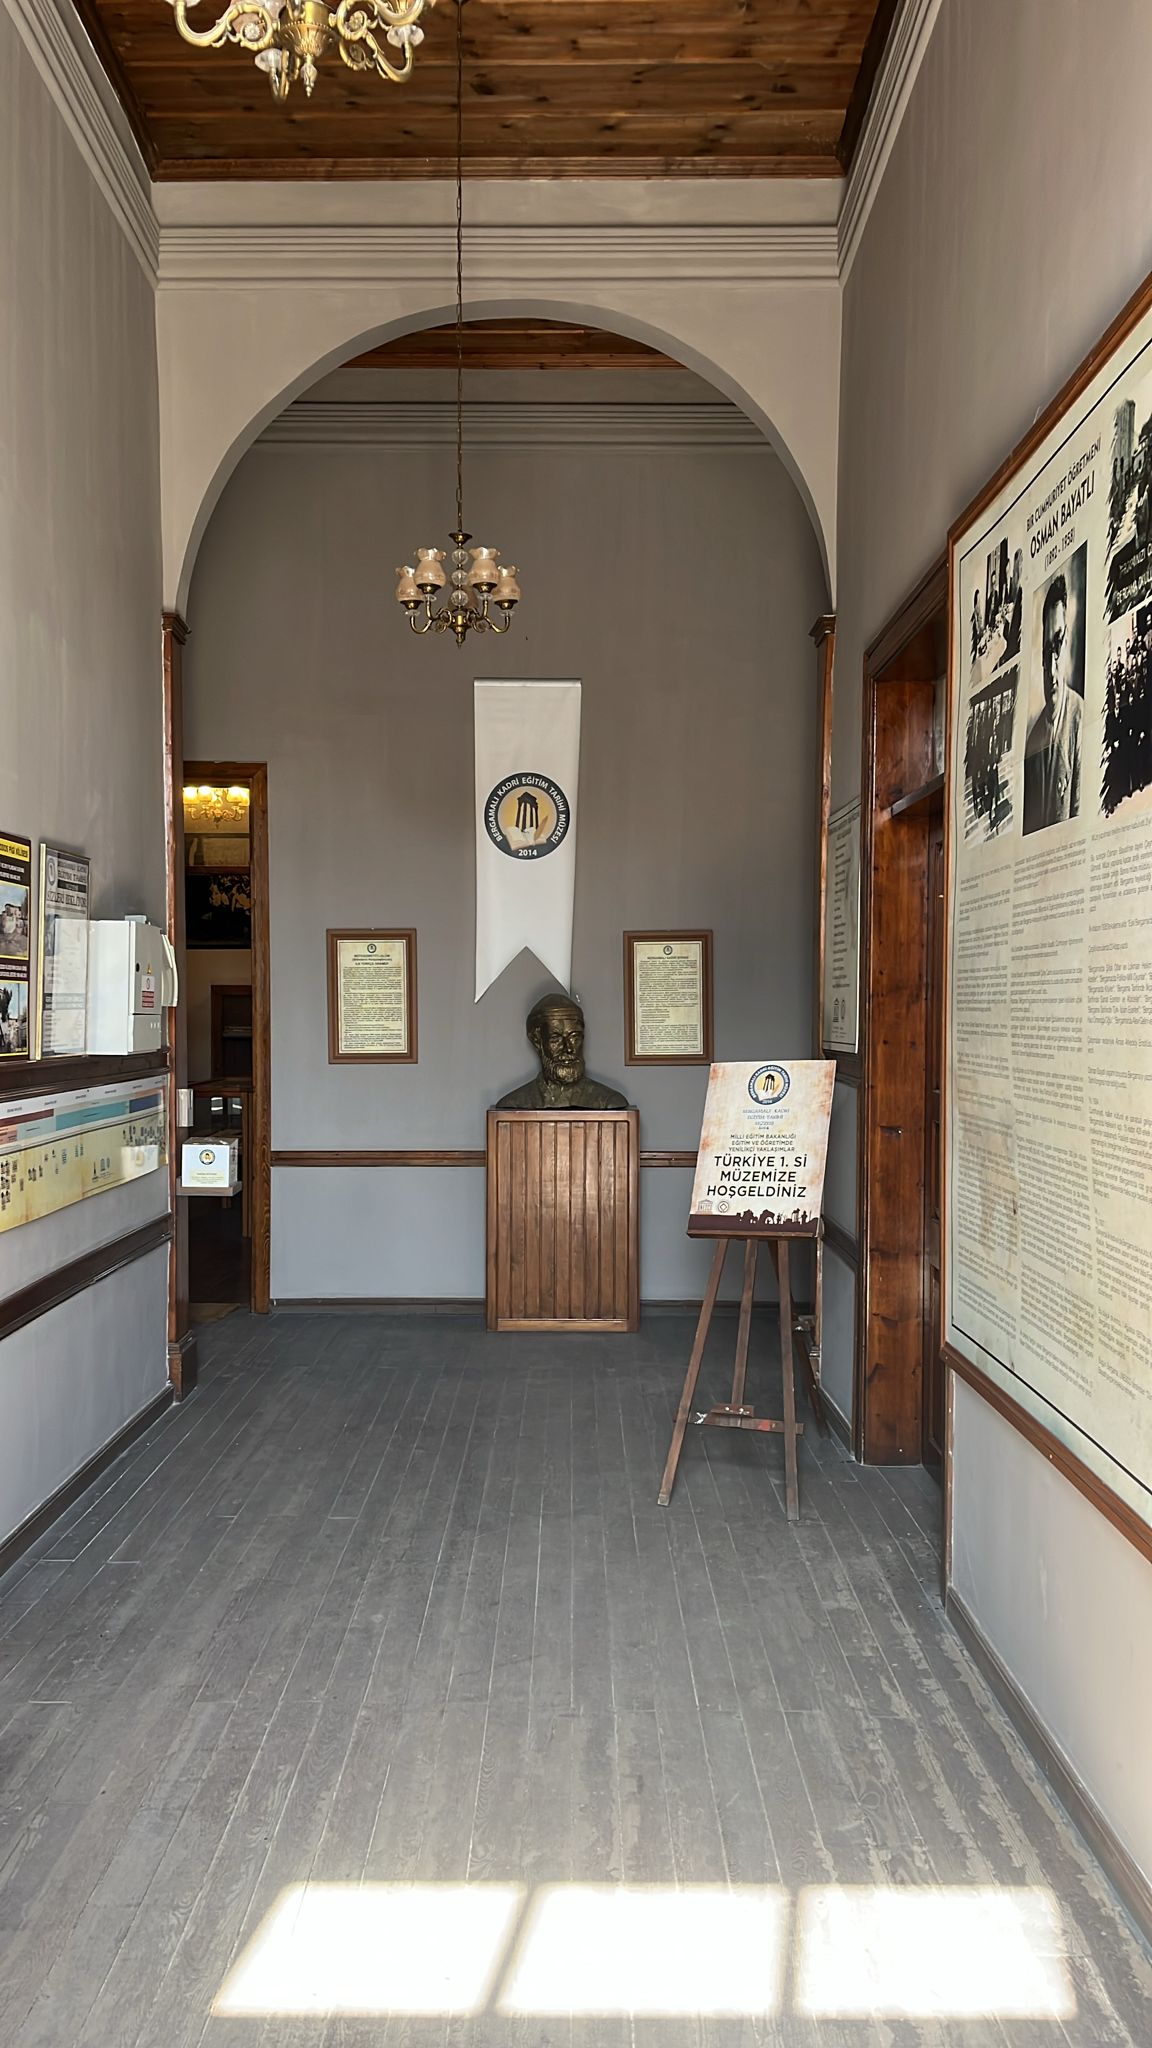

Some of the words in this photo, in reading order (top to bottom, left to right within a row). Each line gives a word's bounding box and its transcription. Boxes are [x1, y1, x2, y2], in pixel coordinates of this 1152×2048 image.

[1034, 476, 1067, 522] CUMHURİYET
[1030, 513, 1059, 559] OSMAN
[1060, 470, 1095, 528] BAYATLI
[496, 777, 520, 797] KADRİ
[521, 776, 549, 790] EĞİTİM
[548, 786, 567, 811] TARİHİ
[488, 796, 503, 843] BERGAMALI
[551, 813, 566, 843] MÜZESİ
[518, 849, 538, 857] 2014
[714, 1153, 776, 1167] TÜRKİYE
[780, 1156, 789, 1167] 1.
[793, 1153, 807, 1168] Sİ
[720, 1169, 797, 1182] MÜZEMİZE
[706, 1183, 807, 1199] HOŞGELDİNİZ
